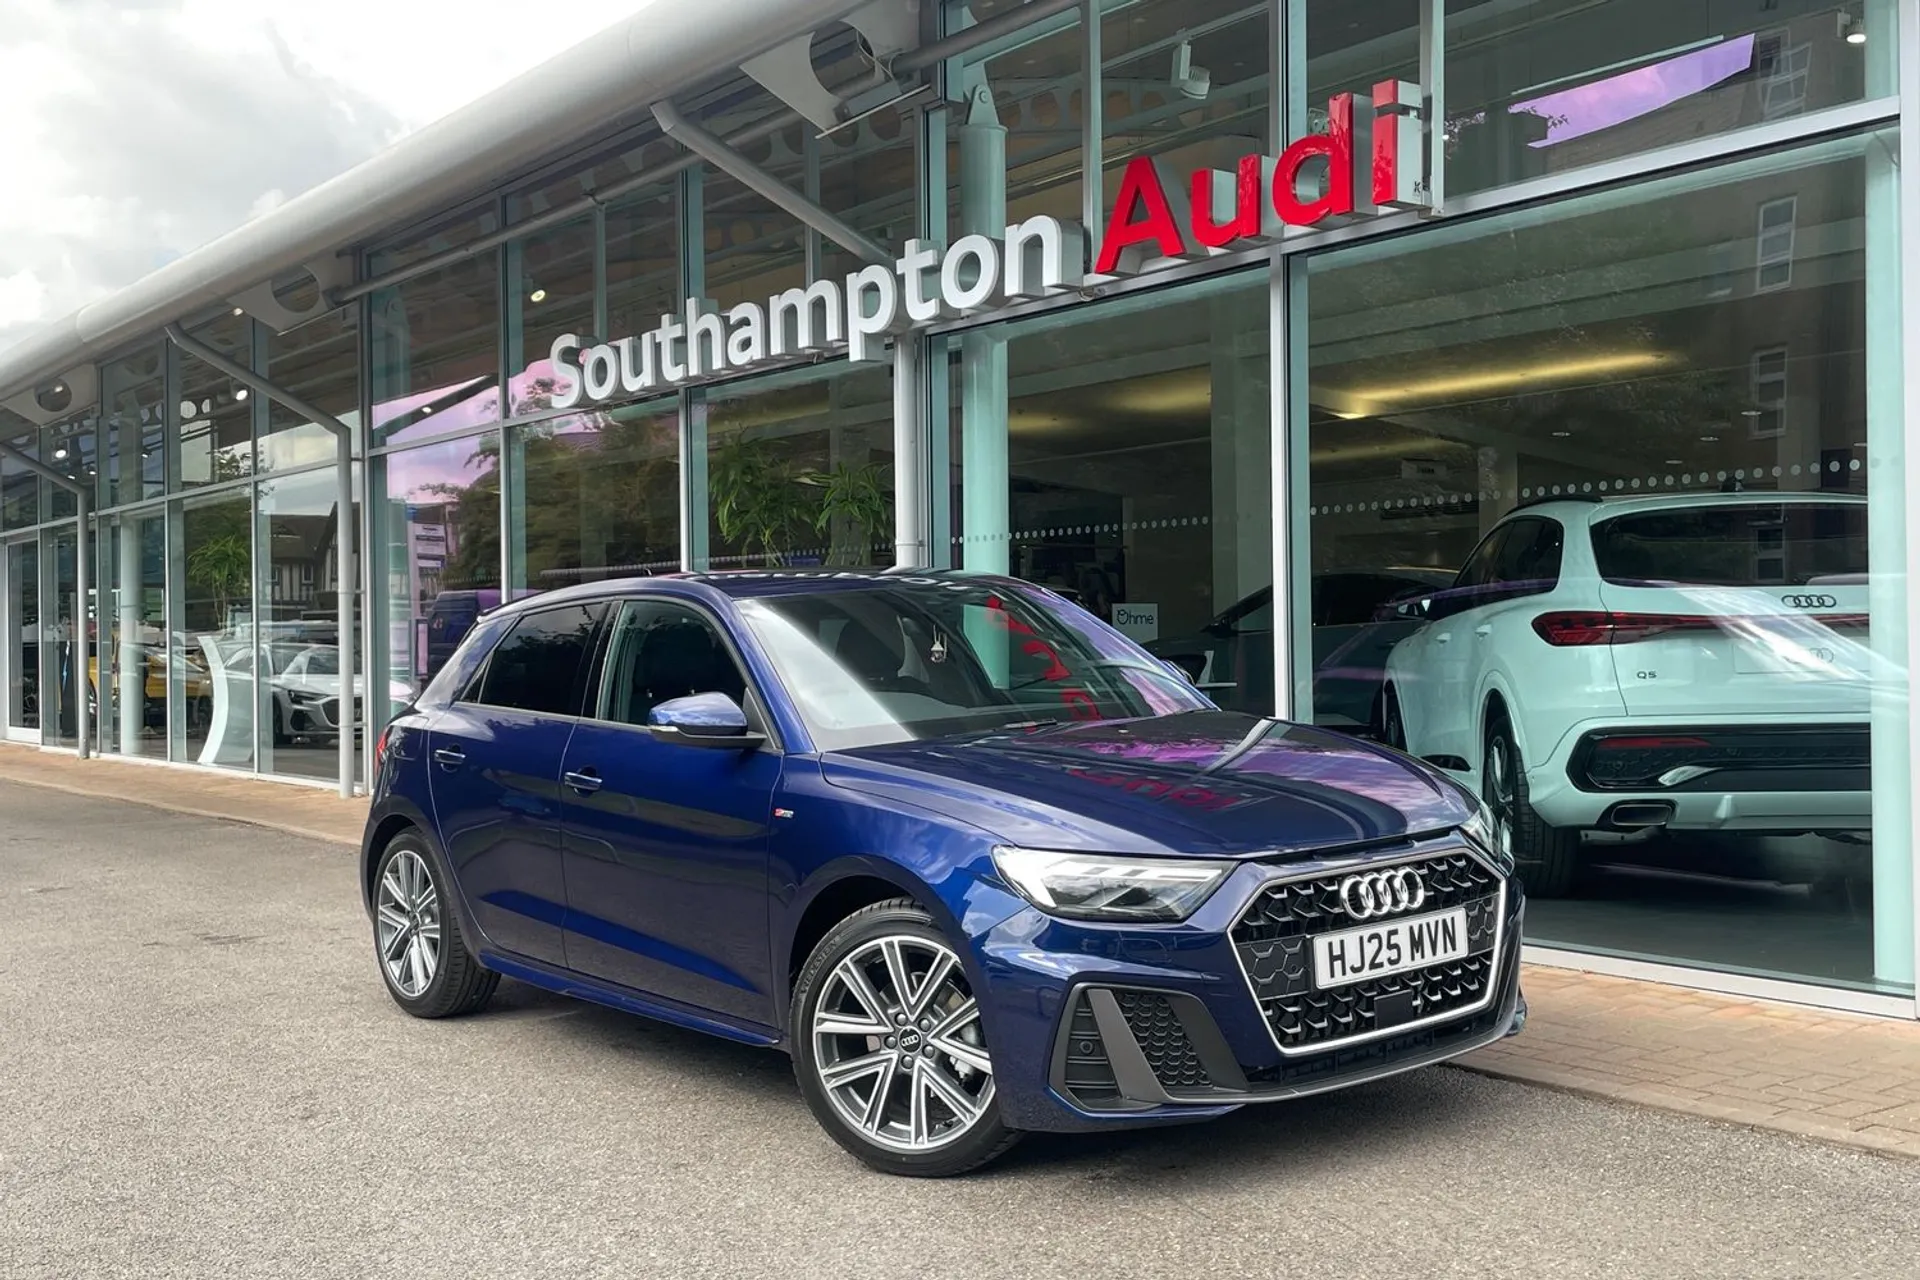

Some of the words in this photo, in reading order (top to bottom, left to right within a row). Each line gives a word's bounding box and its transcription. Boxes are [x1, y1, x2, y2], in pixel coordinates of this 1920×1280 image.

[550, 214, 1063, 409] Southampton
[1095, 79, 1400, 274] Audi
[1117, 609, 1154, 625] Ohme
[1636, 670, 1658, 680] Q5
[1327, 928, 1402, 979] HJ25
[1408, 916, 1457, 962] MVN
